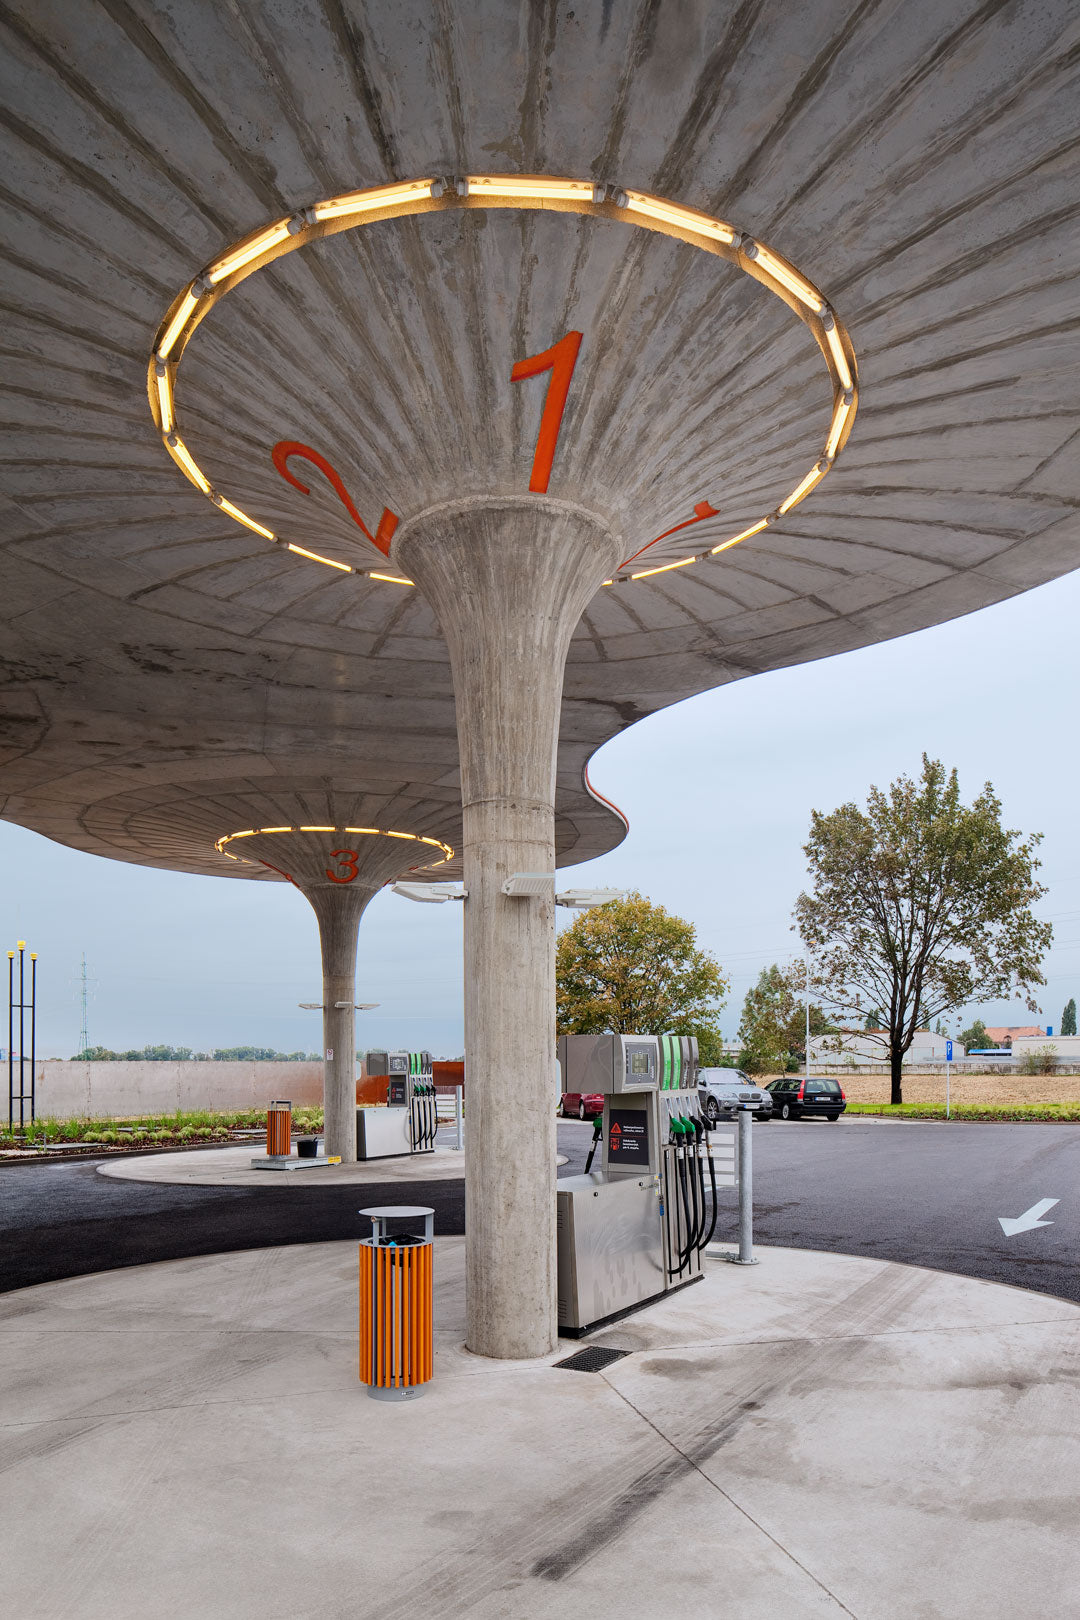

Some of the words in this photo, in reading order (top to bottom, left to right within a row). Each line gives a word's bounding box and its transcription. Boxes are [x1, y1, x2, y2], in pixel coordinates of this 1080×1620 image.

[511, 331, 583, 494] 1
[271, 441, 399, 557] 2
[326, 849, 359, 883] 3
[947, 1043, 952, 1056] P
